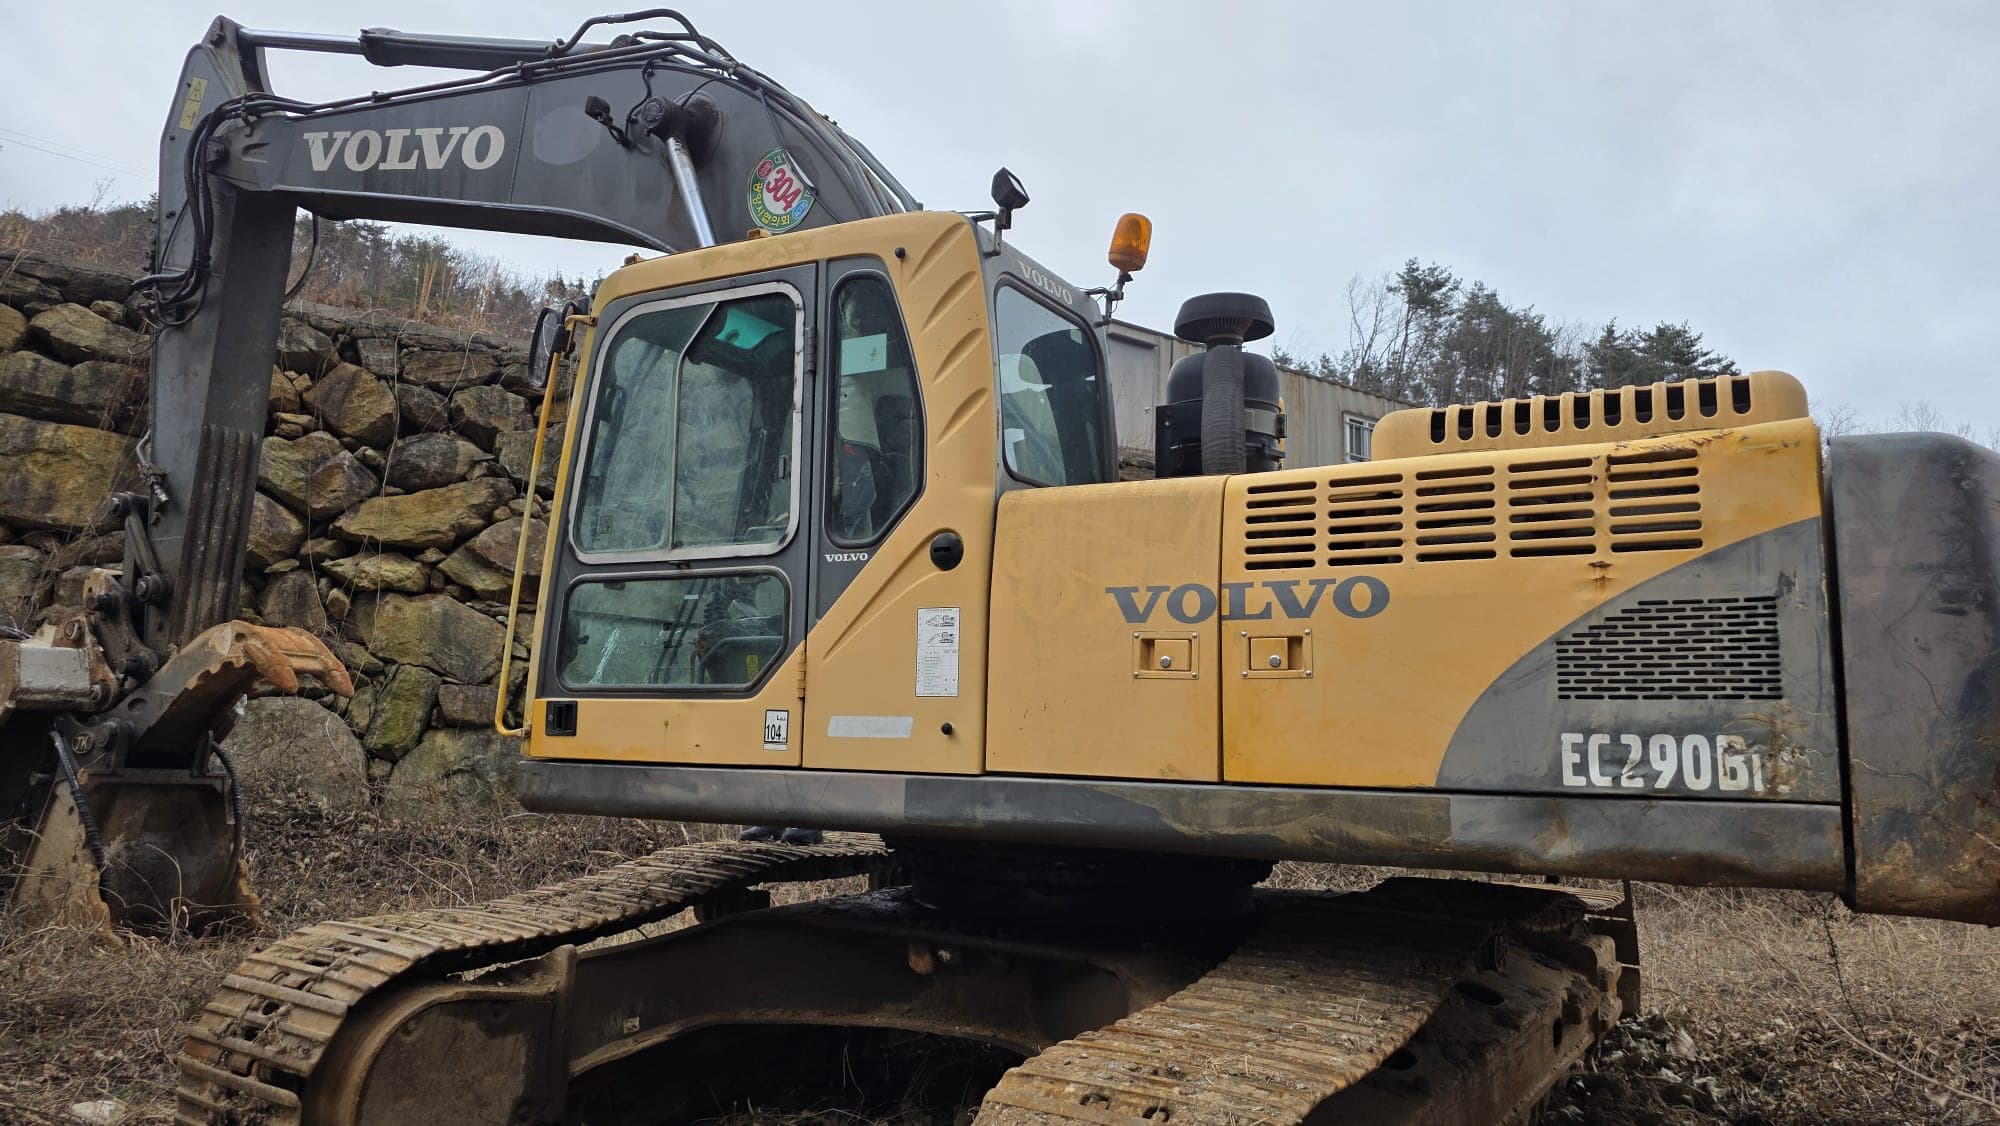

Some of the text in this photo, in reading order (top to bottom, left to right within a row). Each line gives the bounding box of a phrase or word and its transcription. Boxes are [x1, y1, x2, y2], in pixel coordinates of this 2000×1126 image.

[303, 125, 505, 172] VOLVO
[765, 167, 802, 212] 304
[1016, 259, 1073, 305] VOLVO
[823, 552, 868, 562] VOLVO
[1104, 575, 1391, 624] VOLVO
[766, 723, 781, 740] 104
